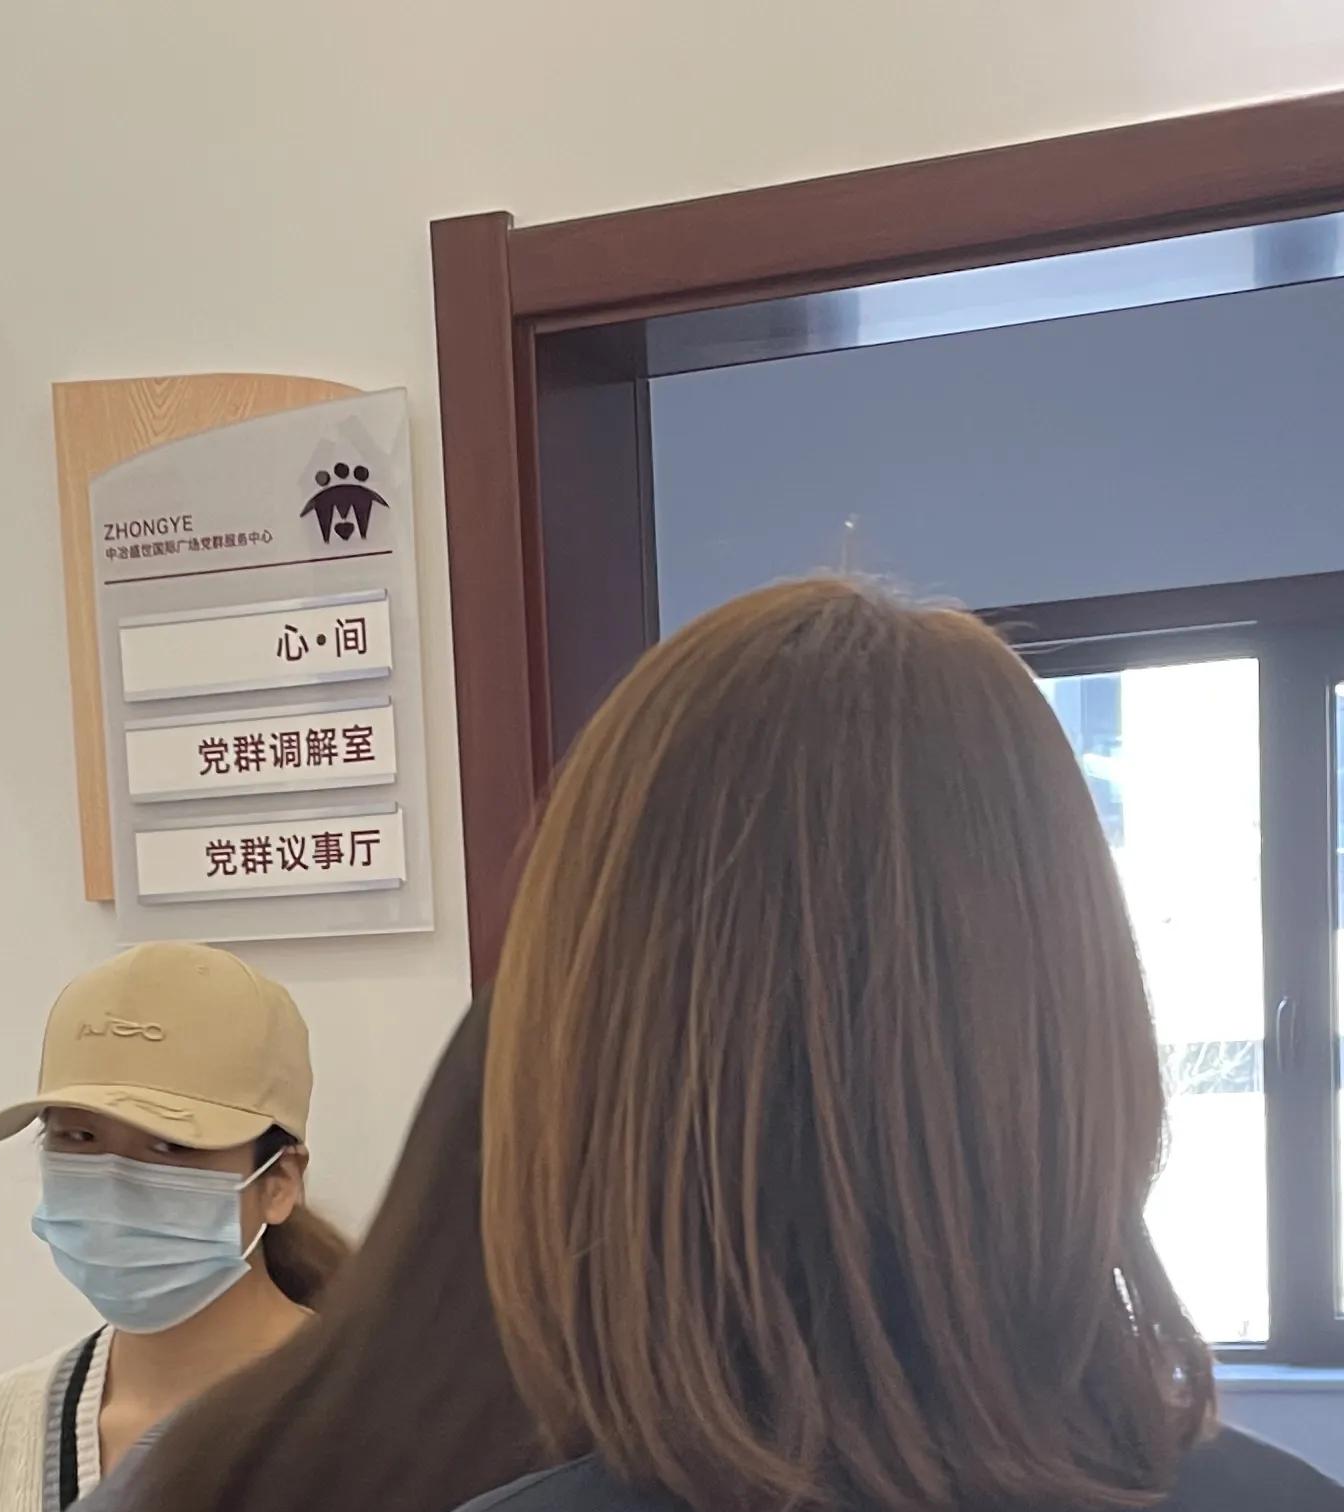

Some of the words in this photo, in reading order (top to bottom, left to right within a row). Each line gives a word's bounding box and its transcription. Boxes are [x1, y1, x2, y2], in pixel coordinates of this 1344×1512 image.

[103, 514, 194, 541] ZHONGYE
[197, 723, 377, 776] 党群调解室
[205, 828, 382, 878] 党群议事厅
